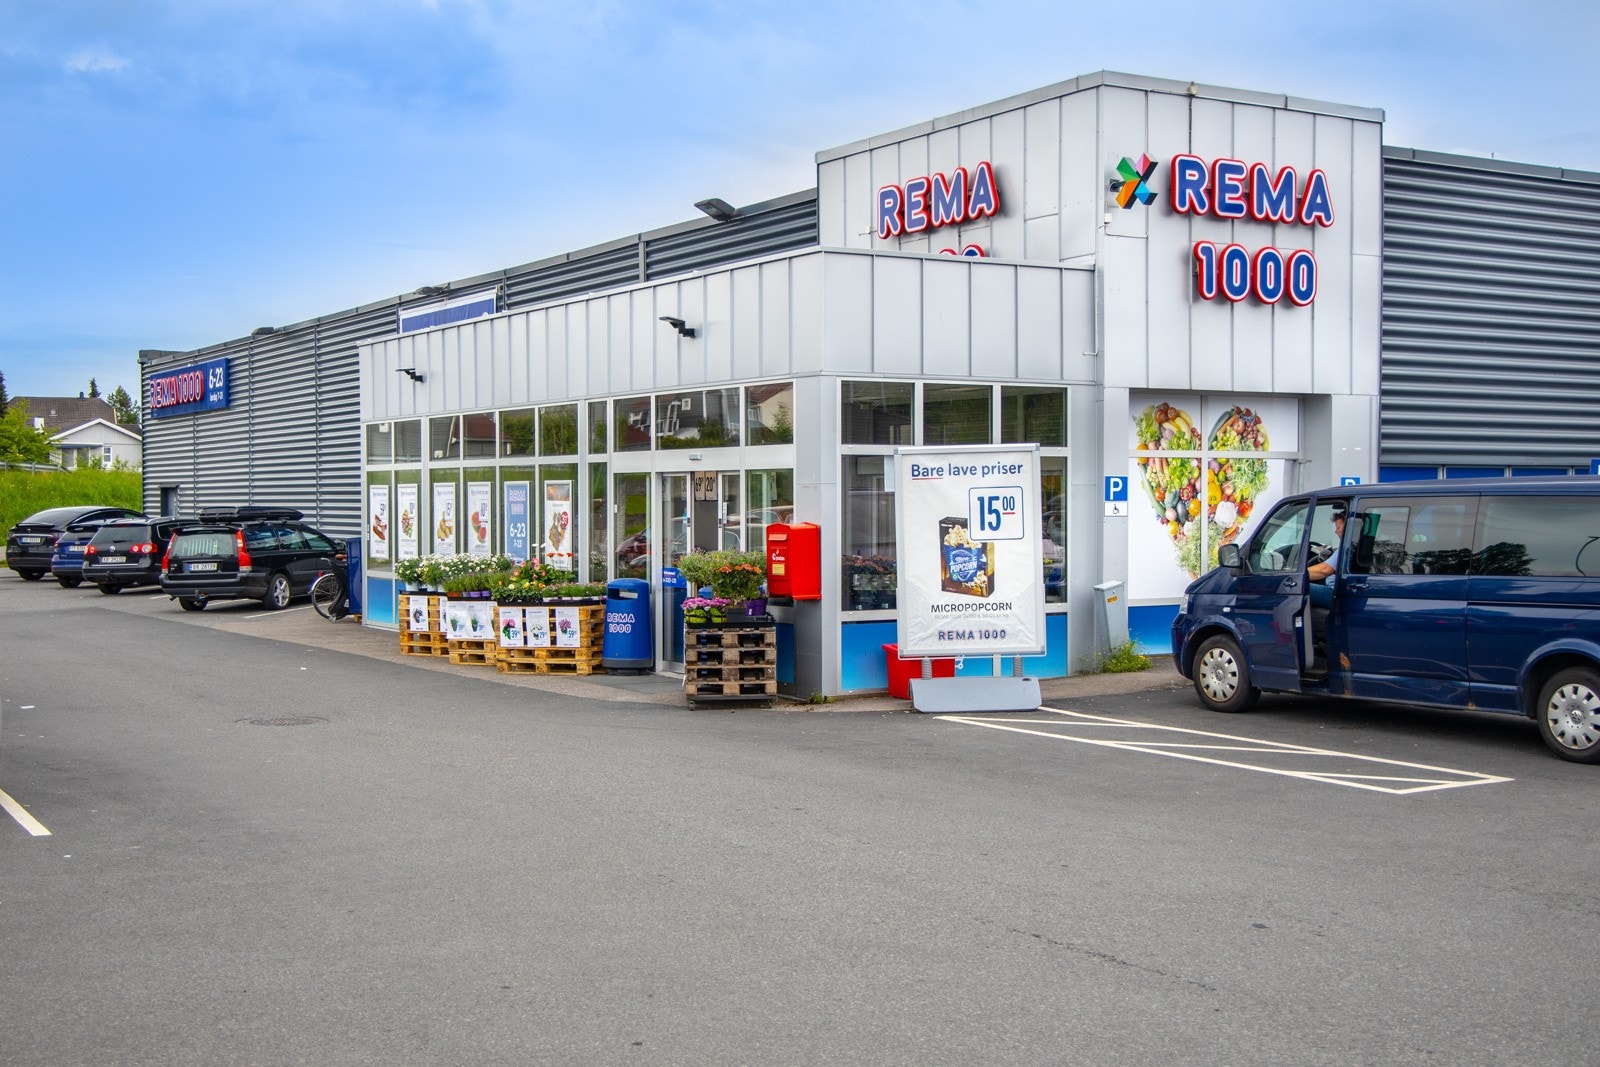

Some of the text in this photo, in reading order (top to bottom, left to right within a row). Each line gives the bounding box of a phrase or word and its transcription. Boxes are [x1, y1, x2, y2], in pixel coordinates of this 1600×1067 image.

[1171, 153, 1335, 227] REMA
[877, 161, 1001, 240] REMA
[1193, 240, 1318, 306] 1000
[209, 367, 224, 389] 6-23
[150, 370, 205, 409] REMA 1000
[911, 462, 1023, 478] Bare lave priser
[509, 490, 526, 502] REMA
[1109, 477, 1123, 500] P
[511, 503, 524, 515] 1000
[509, 523, 526, 538] 6-23
[950, 560, 978, 574] POPCORN
[931, 602, 1012, 613] MICROPOPCORN
[607, 613, 635, 623] REMA
[609, 624, 632, 633] 1000
[938, 629, 1006, 641] REMA 1000
